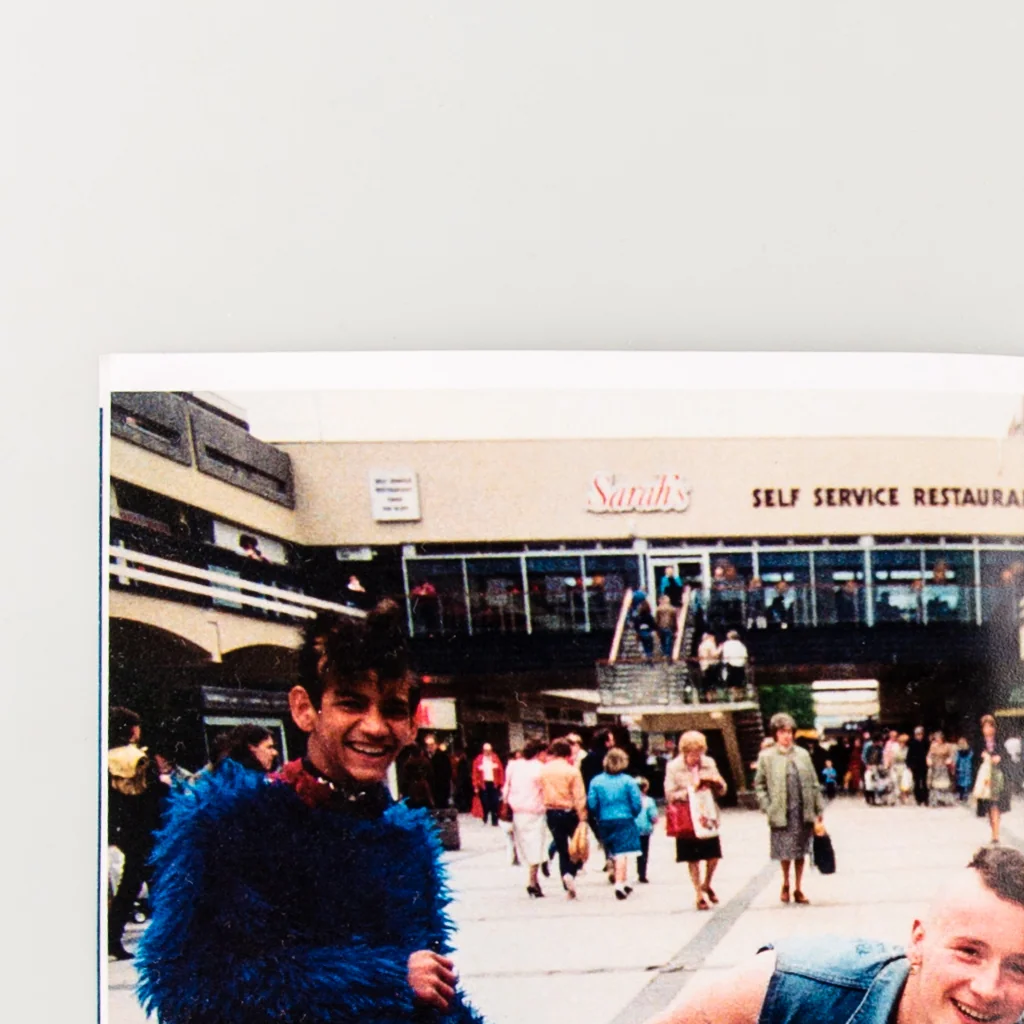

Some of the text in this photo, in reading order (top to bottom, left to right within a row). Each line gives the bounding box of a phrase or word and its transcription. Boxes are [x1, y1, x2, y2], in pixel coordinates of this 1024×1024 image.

[586, 473, 687, 508] Sarah's
[752, 487, 800, 508] SELF
[813, 487, 900, 508] SERVICE
